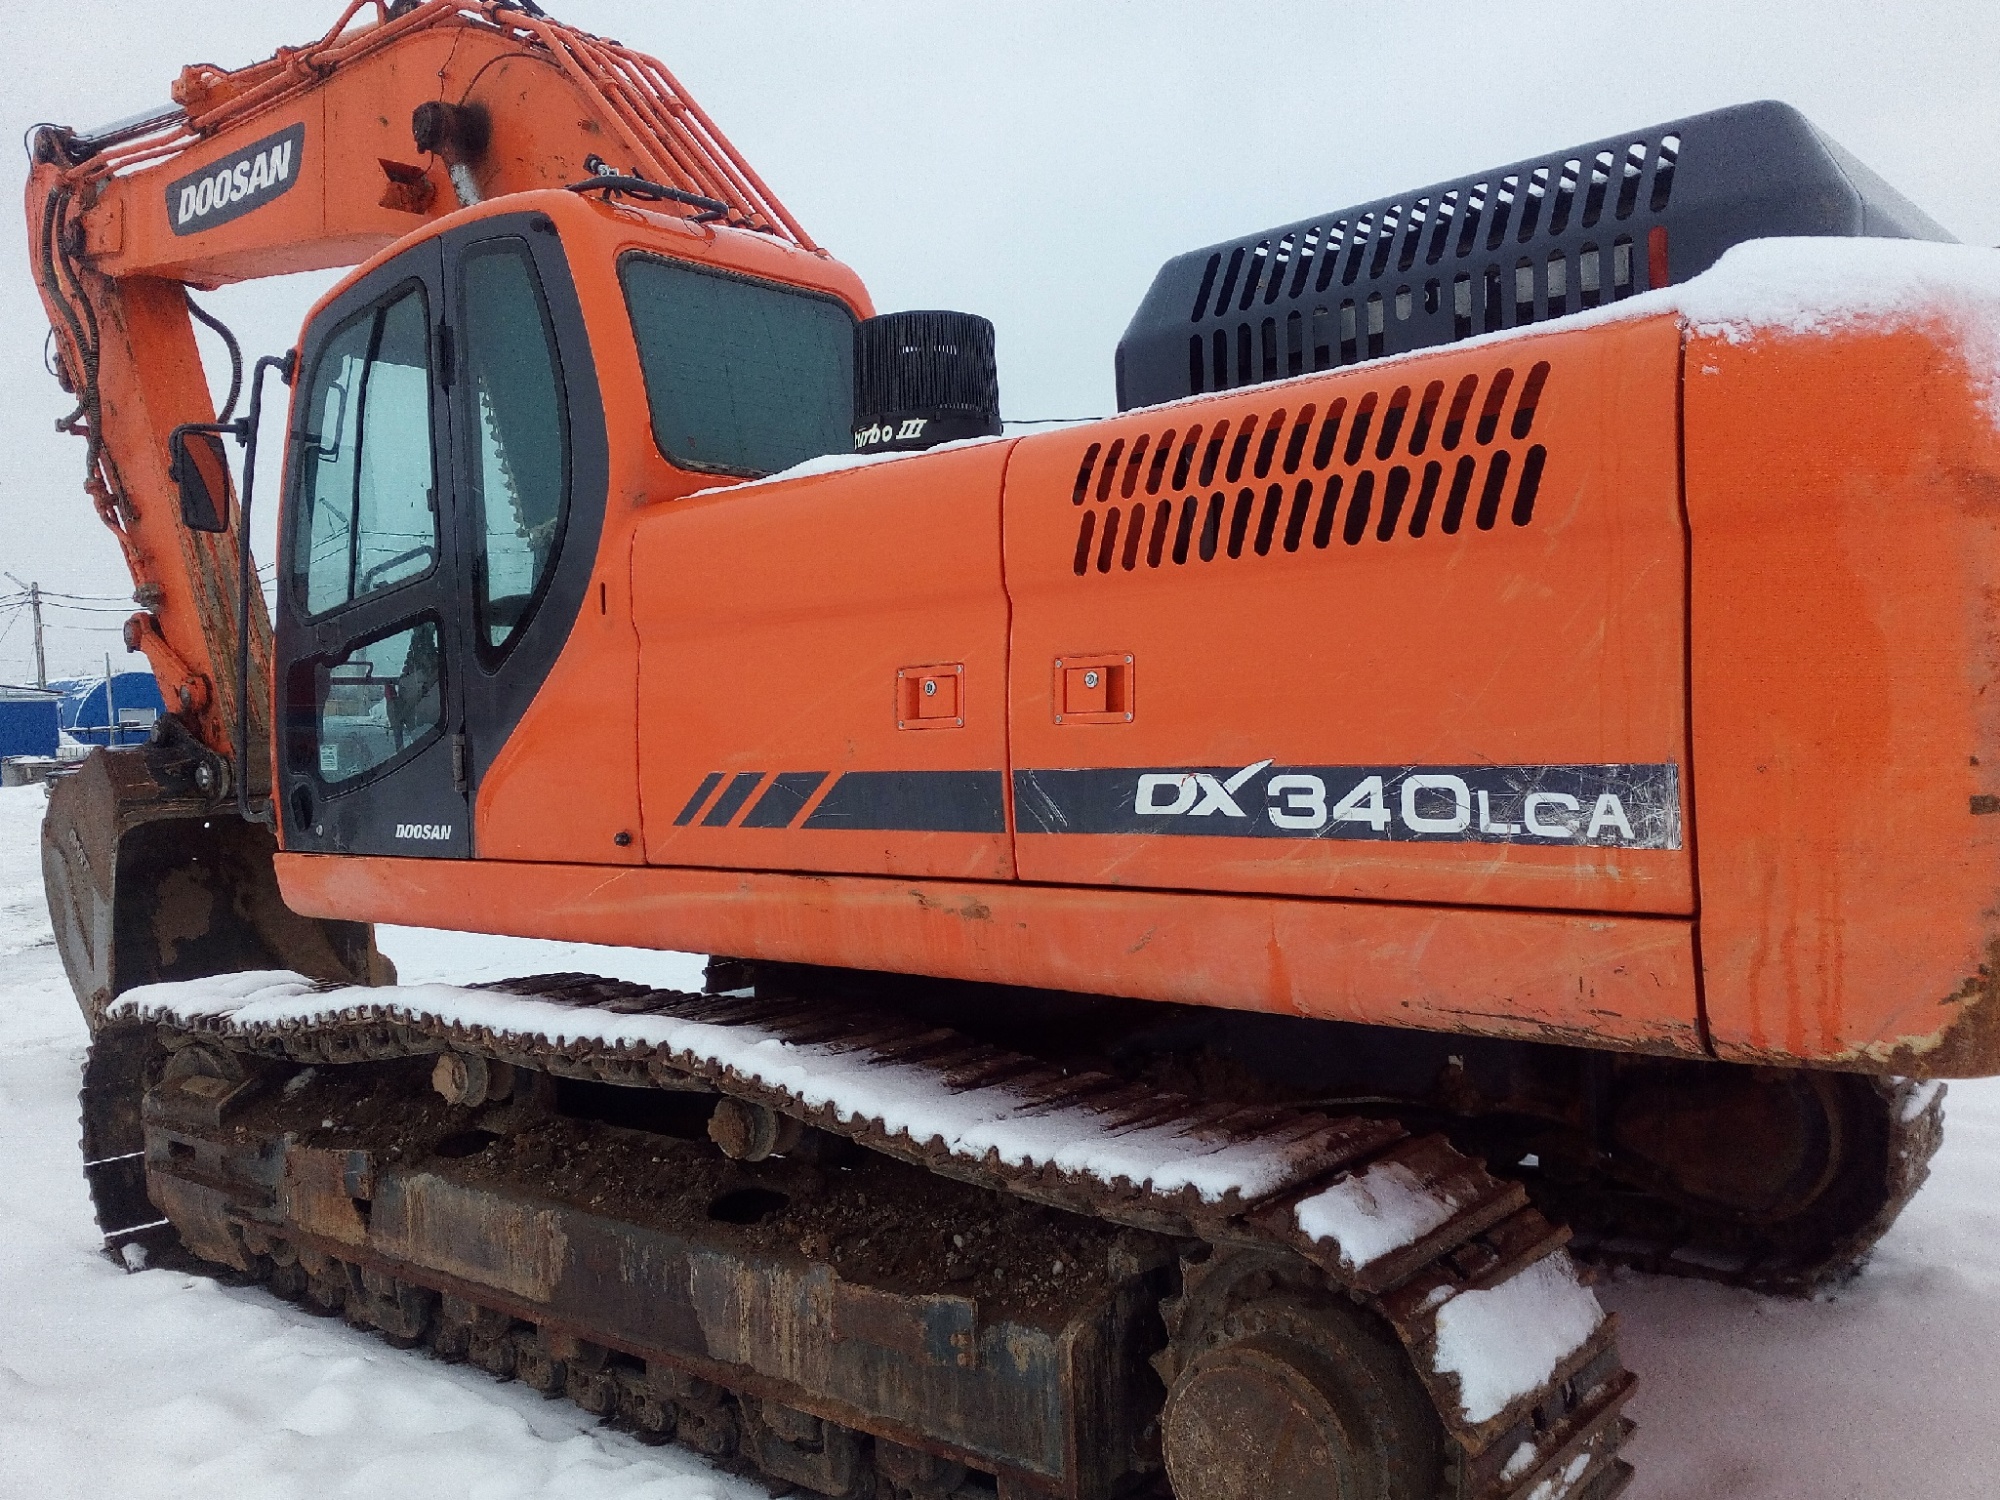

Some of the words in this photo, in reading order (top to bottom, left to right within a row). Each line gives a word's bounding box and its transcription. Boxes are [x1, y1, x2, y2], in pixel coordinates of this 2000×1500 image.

[178, 139, 292, 225] DOOSAN
[895, 417, 928, 440] III
[395, 824, 452, 840] DOOSAN
